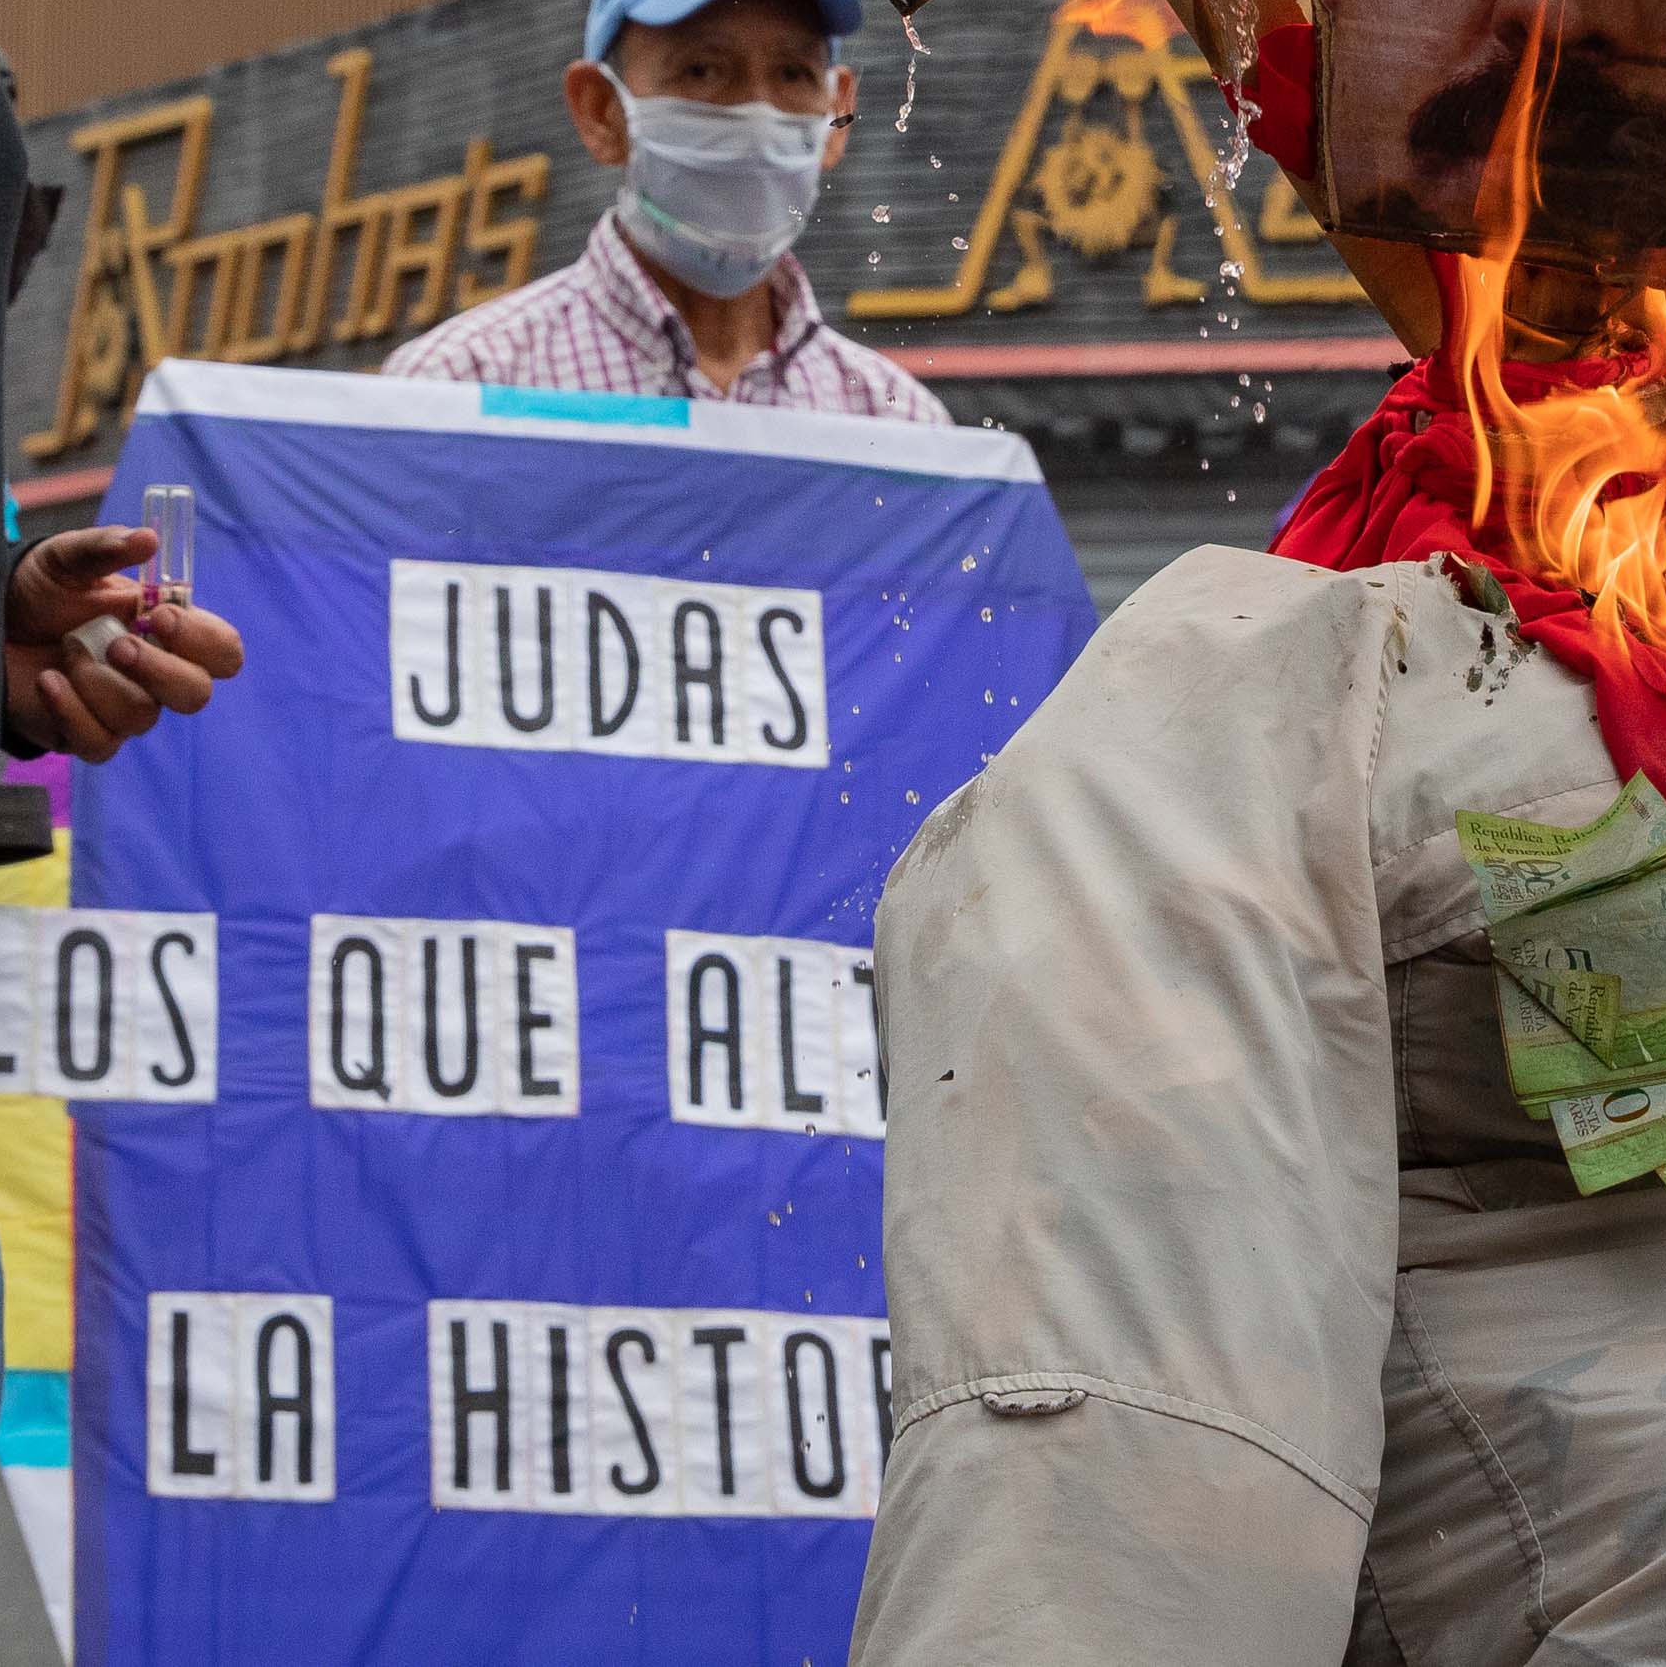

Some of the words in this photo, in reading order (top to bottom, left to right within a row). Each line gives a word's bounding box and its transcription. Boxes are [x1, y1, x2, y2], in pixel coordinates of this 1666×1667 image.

[409, 580, 808, 754] JUDAS
[1469, 821, 1543, 846] República
[1474, 838, 1492, 853] de
[1497, 842, 1572, 857] Venezuela
[330, 933, 562, 1101] QUE
[689, 953, 889, 1122] ALT
[169, 1309, 315, 1487] LA
[448, 1319, 894, 1500] HISTO
